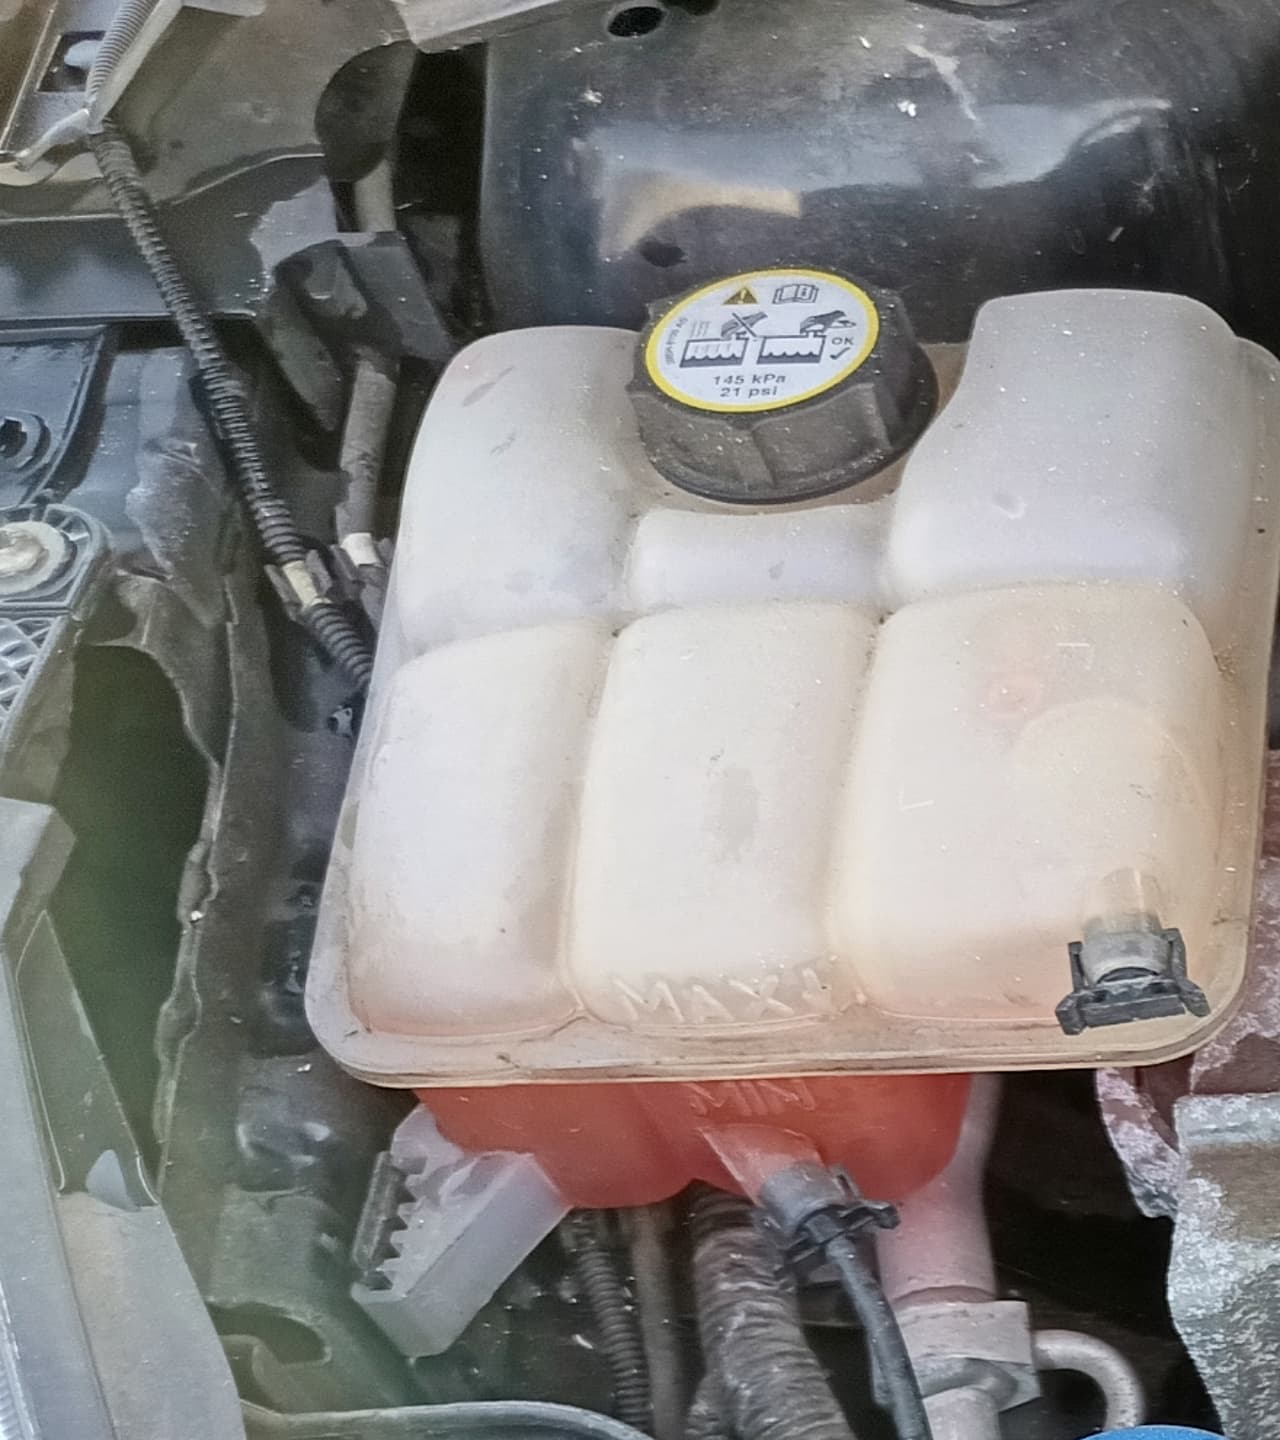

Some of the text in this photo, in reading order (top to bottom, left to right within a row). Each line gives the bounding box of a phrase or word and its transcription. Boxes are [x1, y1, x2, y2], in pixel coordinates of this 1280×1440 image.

[831, 336, 855, 346] OK
[713, 373, 787, 386] 145 kPa
[720, 386, 778, 399] 21 psi
